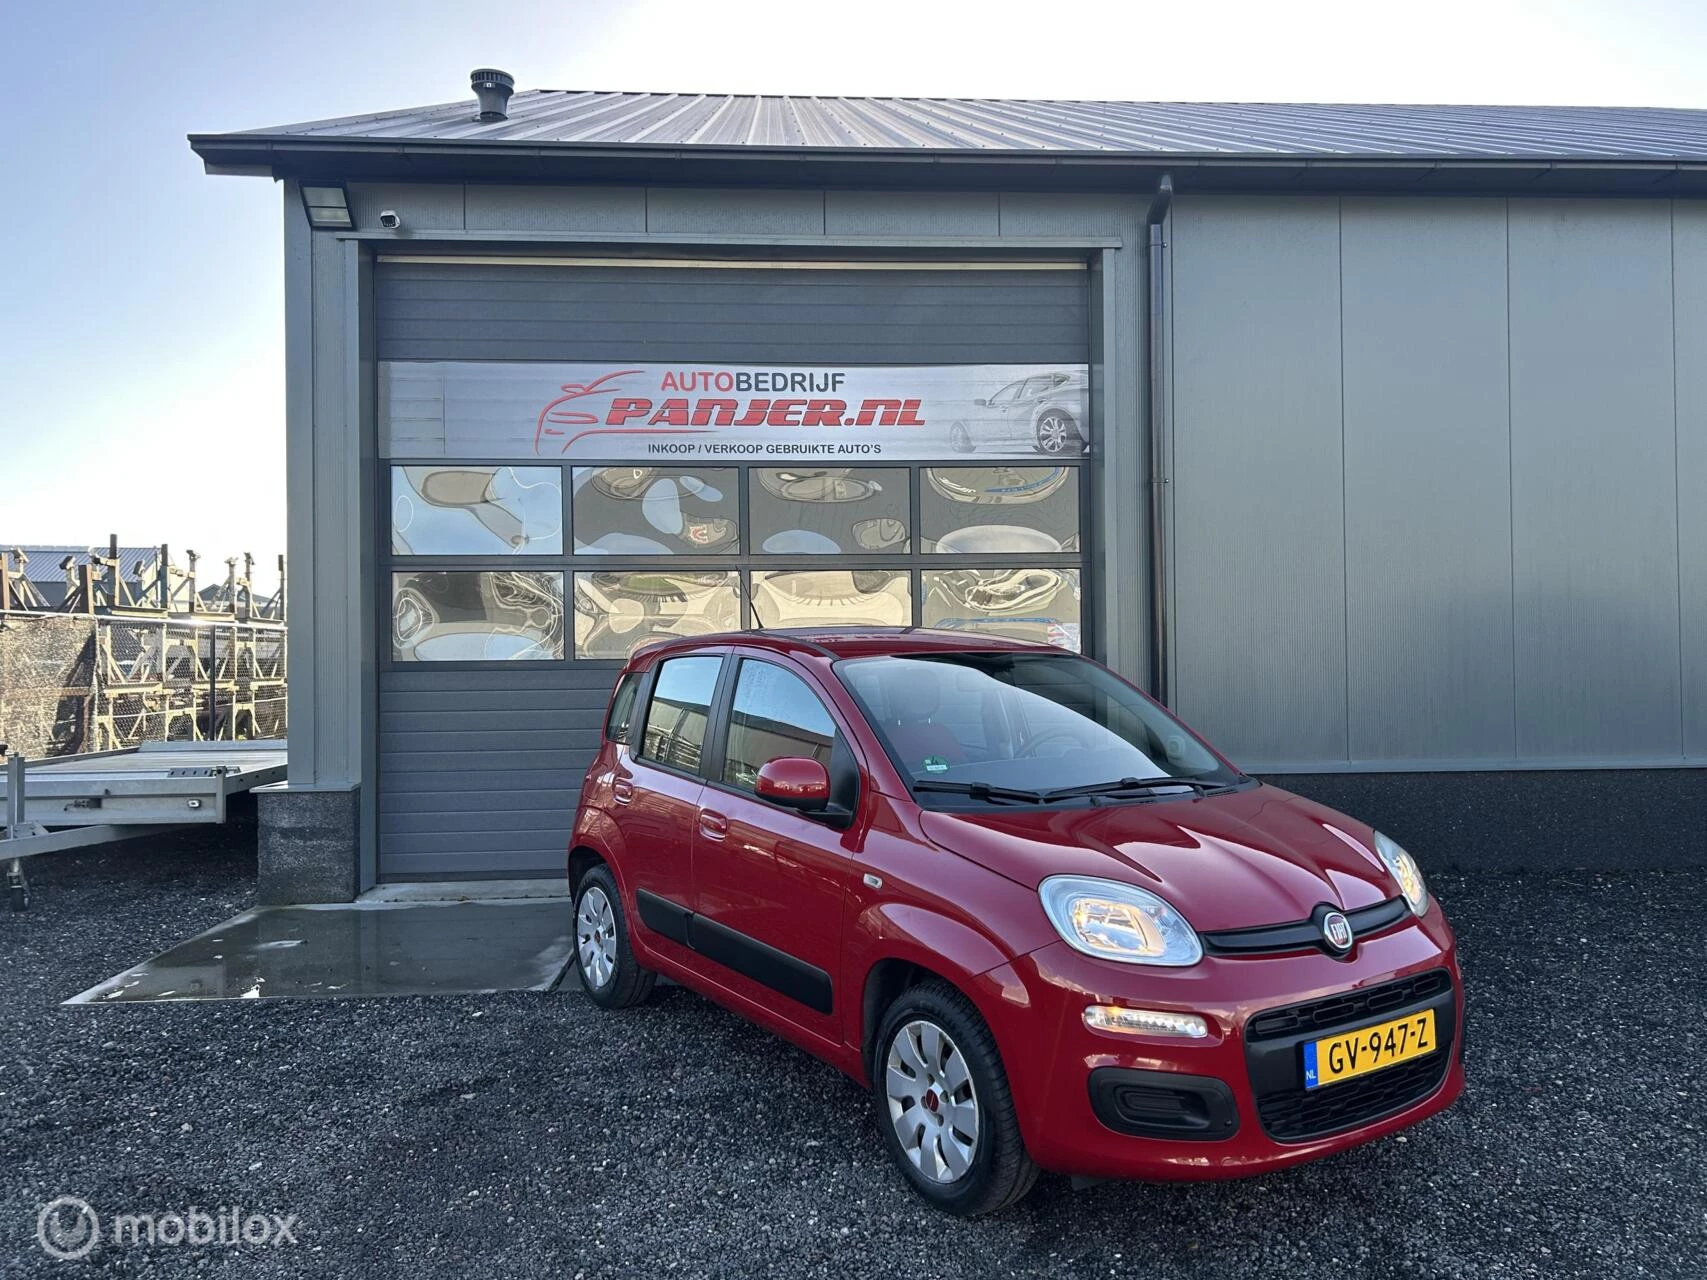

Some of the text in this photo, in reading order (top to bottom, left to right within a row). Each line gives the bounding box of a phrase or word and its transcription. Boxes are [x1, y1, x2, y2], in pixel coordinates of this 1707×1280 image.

[661, 371, 845, 393] AUTOBEDRIJF
[648, 443, 882, 454] INKOOP / VERKOOP GEBRUIKTE AUTO'S
[1305, 1017, 1429, 1081] NL GV-947-Z
